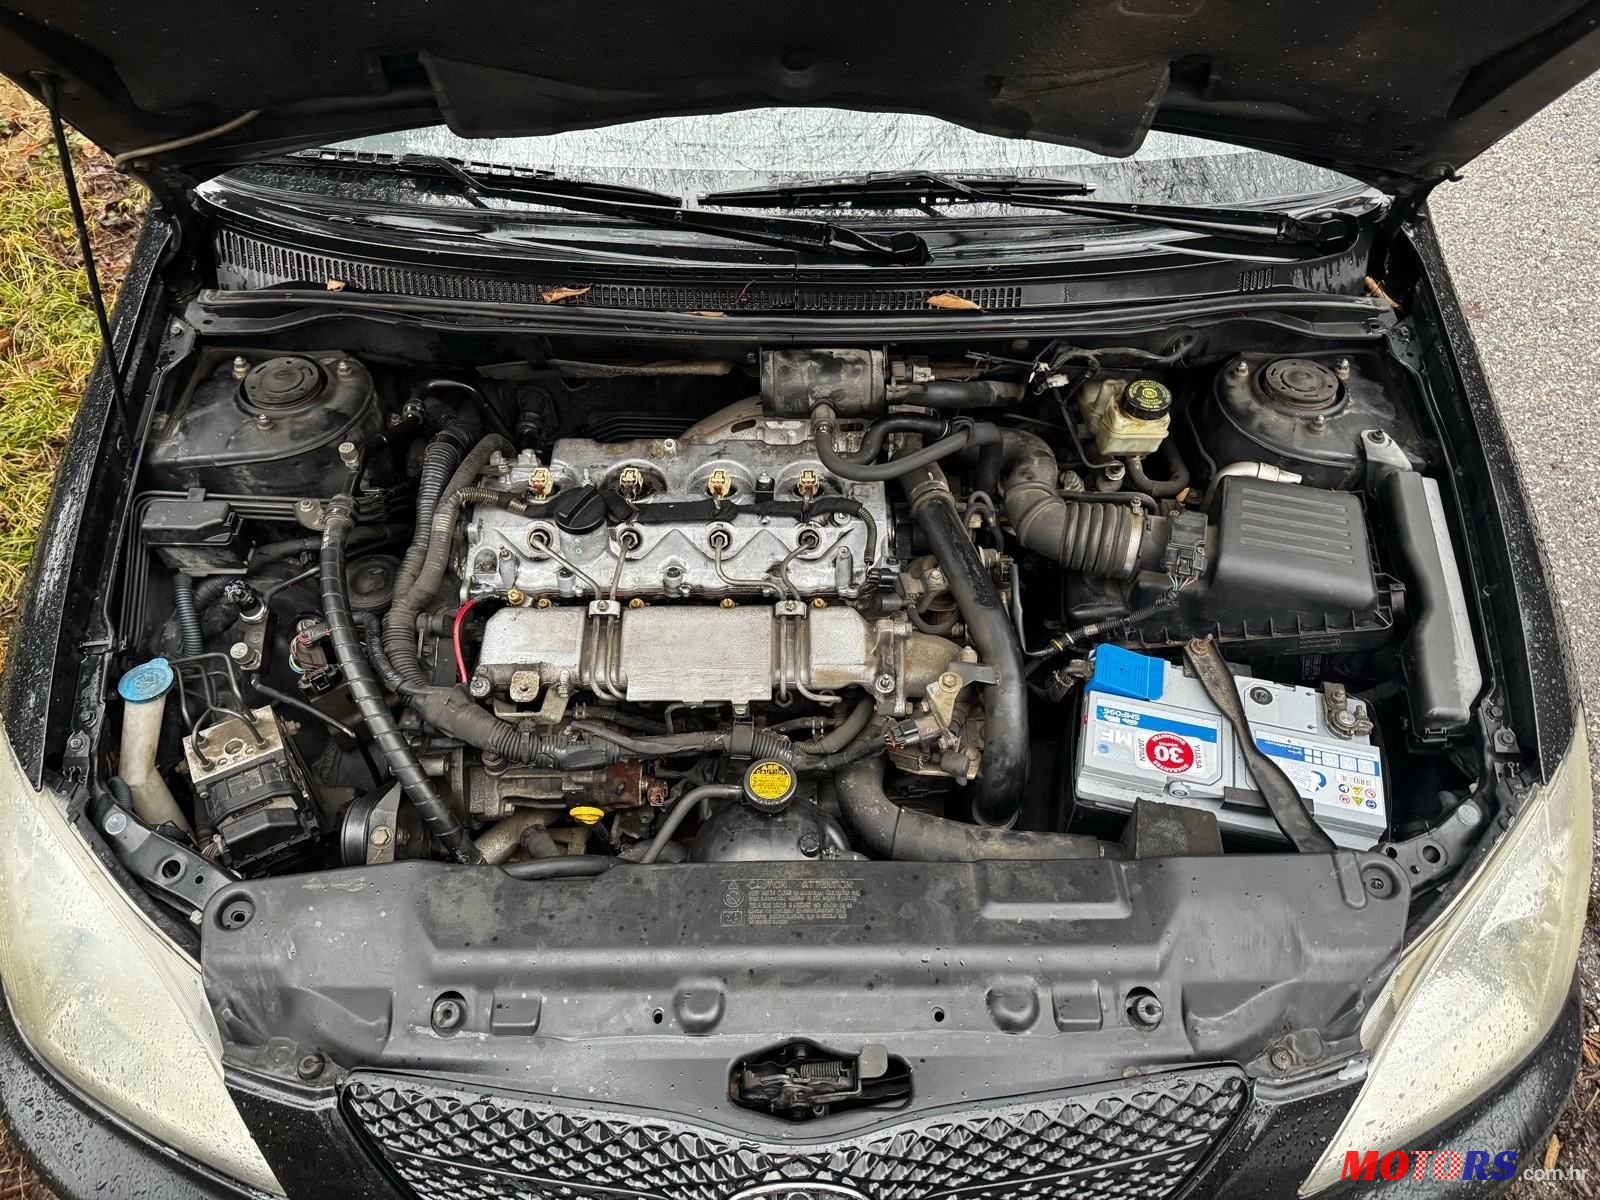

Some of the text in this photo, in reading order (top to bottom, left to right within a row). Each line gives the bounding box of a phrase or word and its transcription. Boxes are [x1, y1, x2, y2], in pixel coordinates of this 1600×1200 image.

[1103, 707, 1140, 721] SMF096
[1101, 729, 1132, 747] MF
[1153, 745, 1185, 764] 30
[1194, 744, 1203, 769] YUASA
